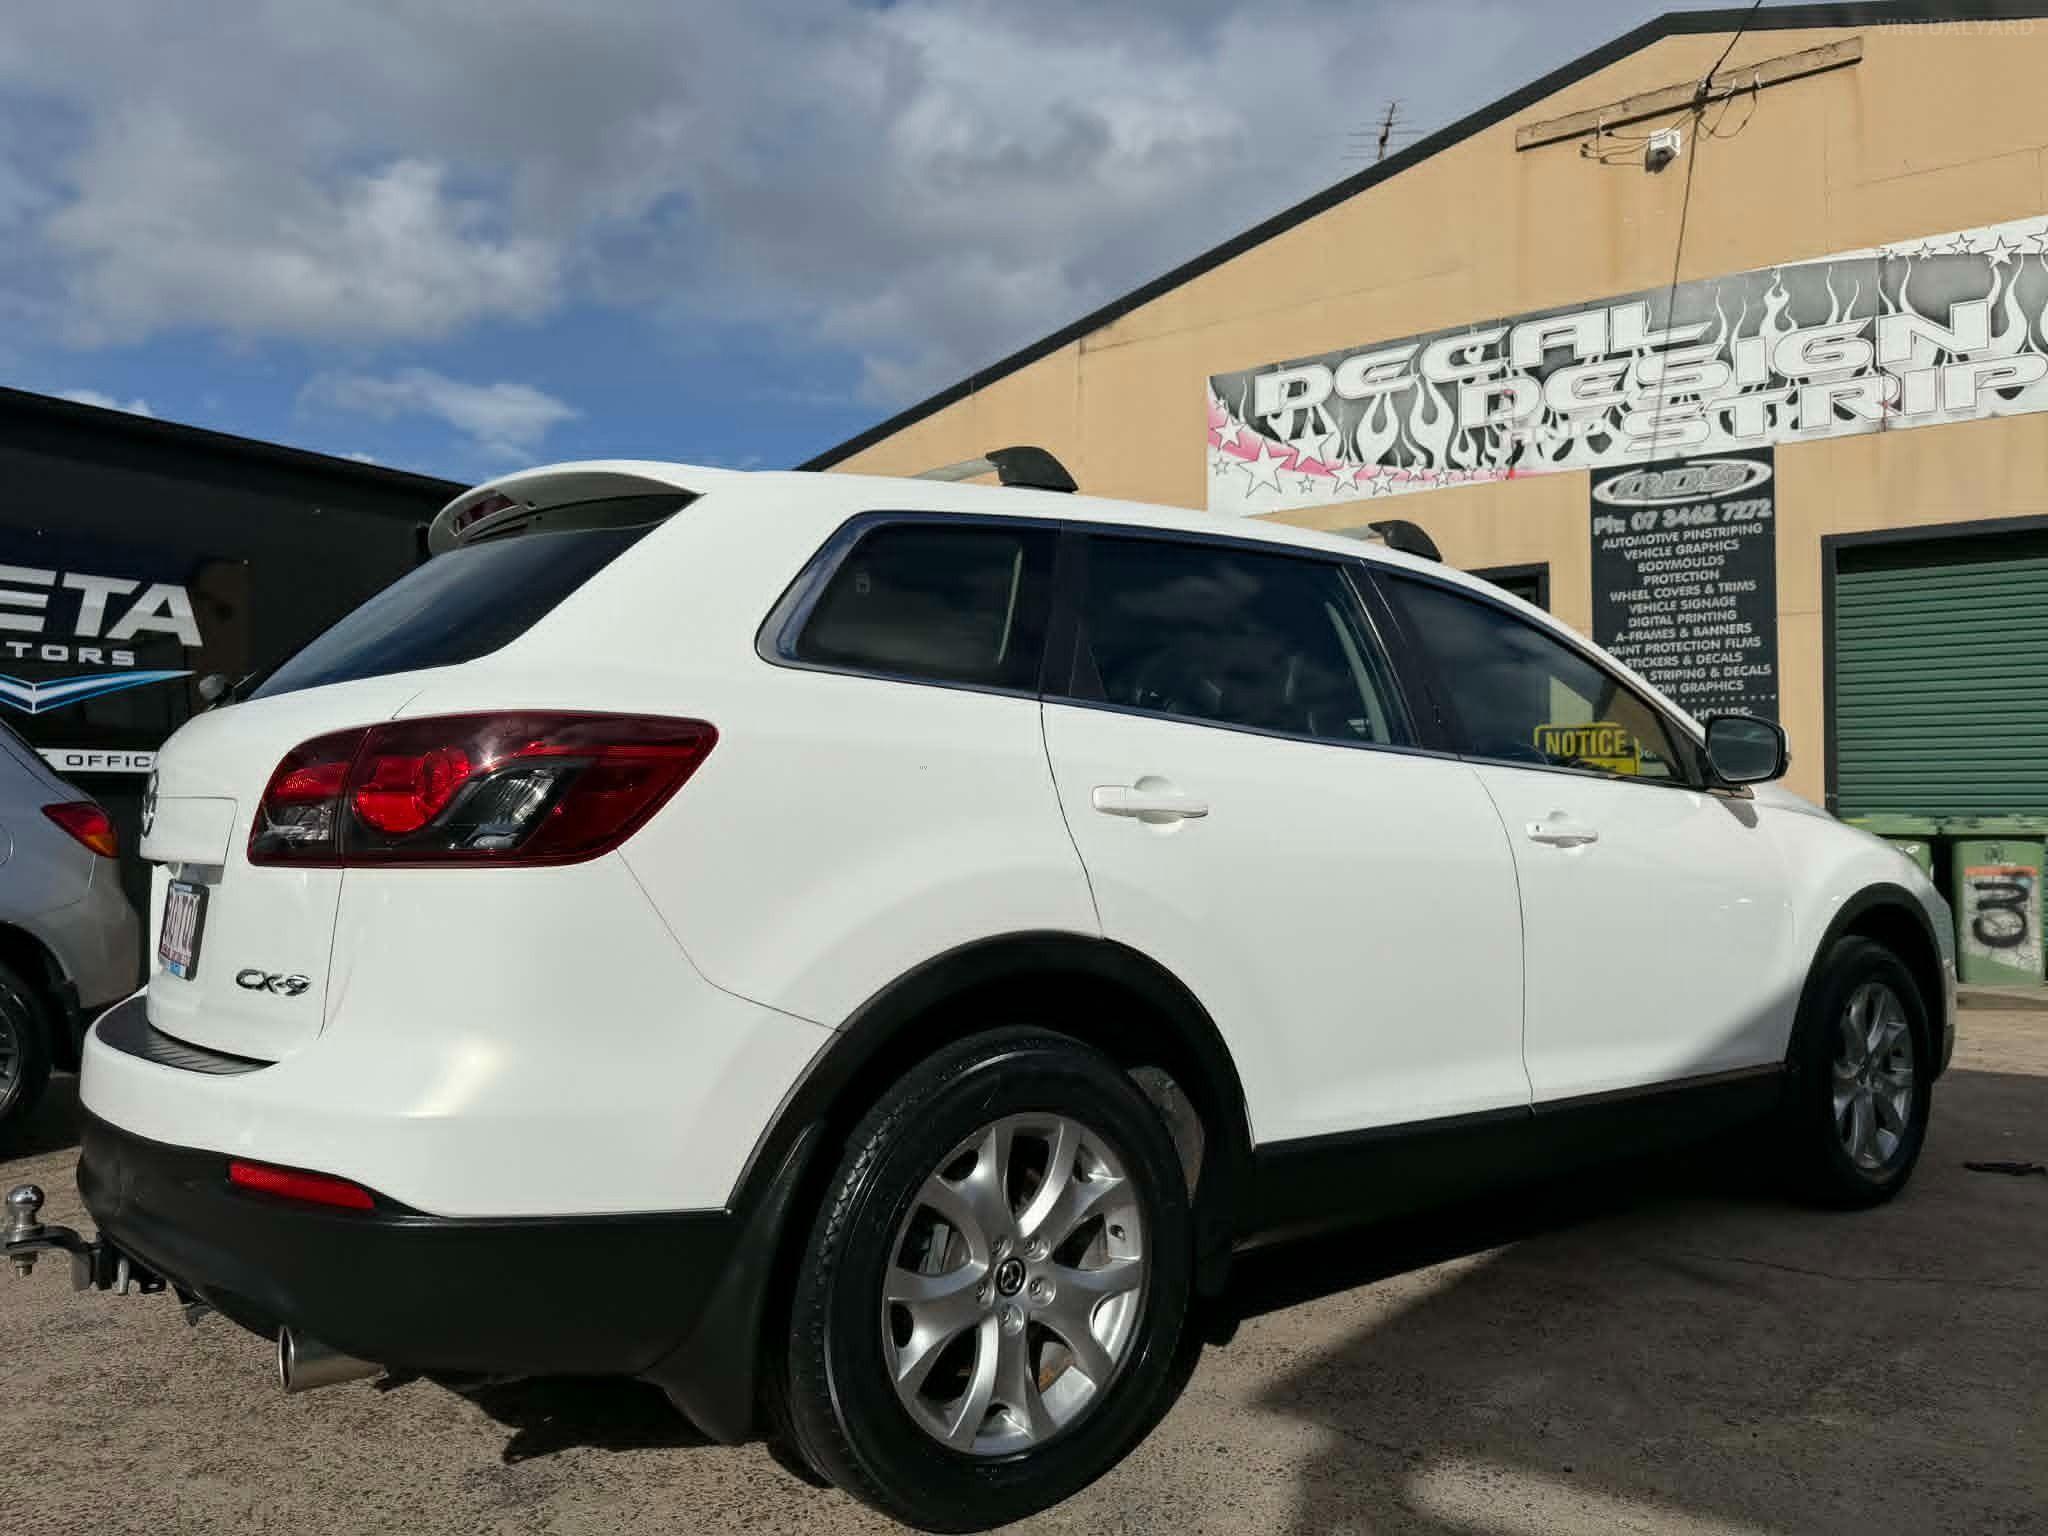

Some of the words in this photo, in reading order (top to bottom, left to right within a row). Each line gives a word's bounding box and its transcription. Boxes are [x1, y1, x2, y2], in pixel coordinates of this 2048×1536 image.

[1457, 298, 1990, 429] DESIGN
[1631, 510, 1658, 531] 07
[1721, 498, 1773, 521] 7272
[1602, 532, 1680, 550] AUTOMOTIVE
[1683, 523, 1763, 541] PINSTRIPING
[1624, 546, 1673, 561] VEHICLE
[1676, 539, 1740, 555] GRAPHICS
[1637, 555, 1725, 573] BODYMOULDS
[1643, 569, 1720, 585] PROTECTION
[1609, 589, 1651, 602] WHEEL
[1654, 584, 1700, 599] COVERS
[1704, 583, 1714, 594] &
[1718, 580, 1757, 593] TRIMS
[1628, 601, 1677, 615] VEHICLE
[1680, 596, 1737, 611] SIGNAGE
[1628, 615, 1674, 628] DIGITAL
[1677, 610, 1737, 624] PRINTING
[1616, 628, 1676, 642] A-FRAMES
[1679, 628, 1689, 638] &
[1693, 623, 1752, 637] BANNERS
[1645, 639, 1721, 653] PROTECTION
[1725, 636, 1761, 649] FILMS
[1625, 655, 1680, 669] STICKERS
[1682, 655, 1692, 666] &
[1696, 652, 1743, 665] DECALS
[1650, 667, 1706, 681] STRIPING
[1710, 667, 1721, 678] &
[1723, 663, 1772, 677] DECALS
[1680, 680, 1745, 694] GRAPHICS
[1545, 729, 1629, 757] NOTICE
[66, 754, 152, 768] OFFIC
[235, 968, 313, 996] CX-9
